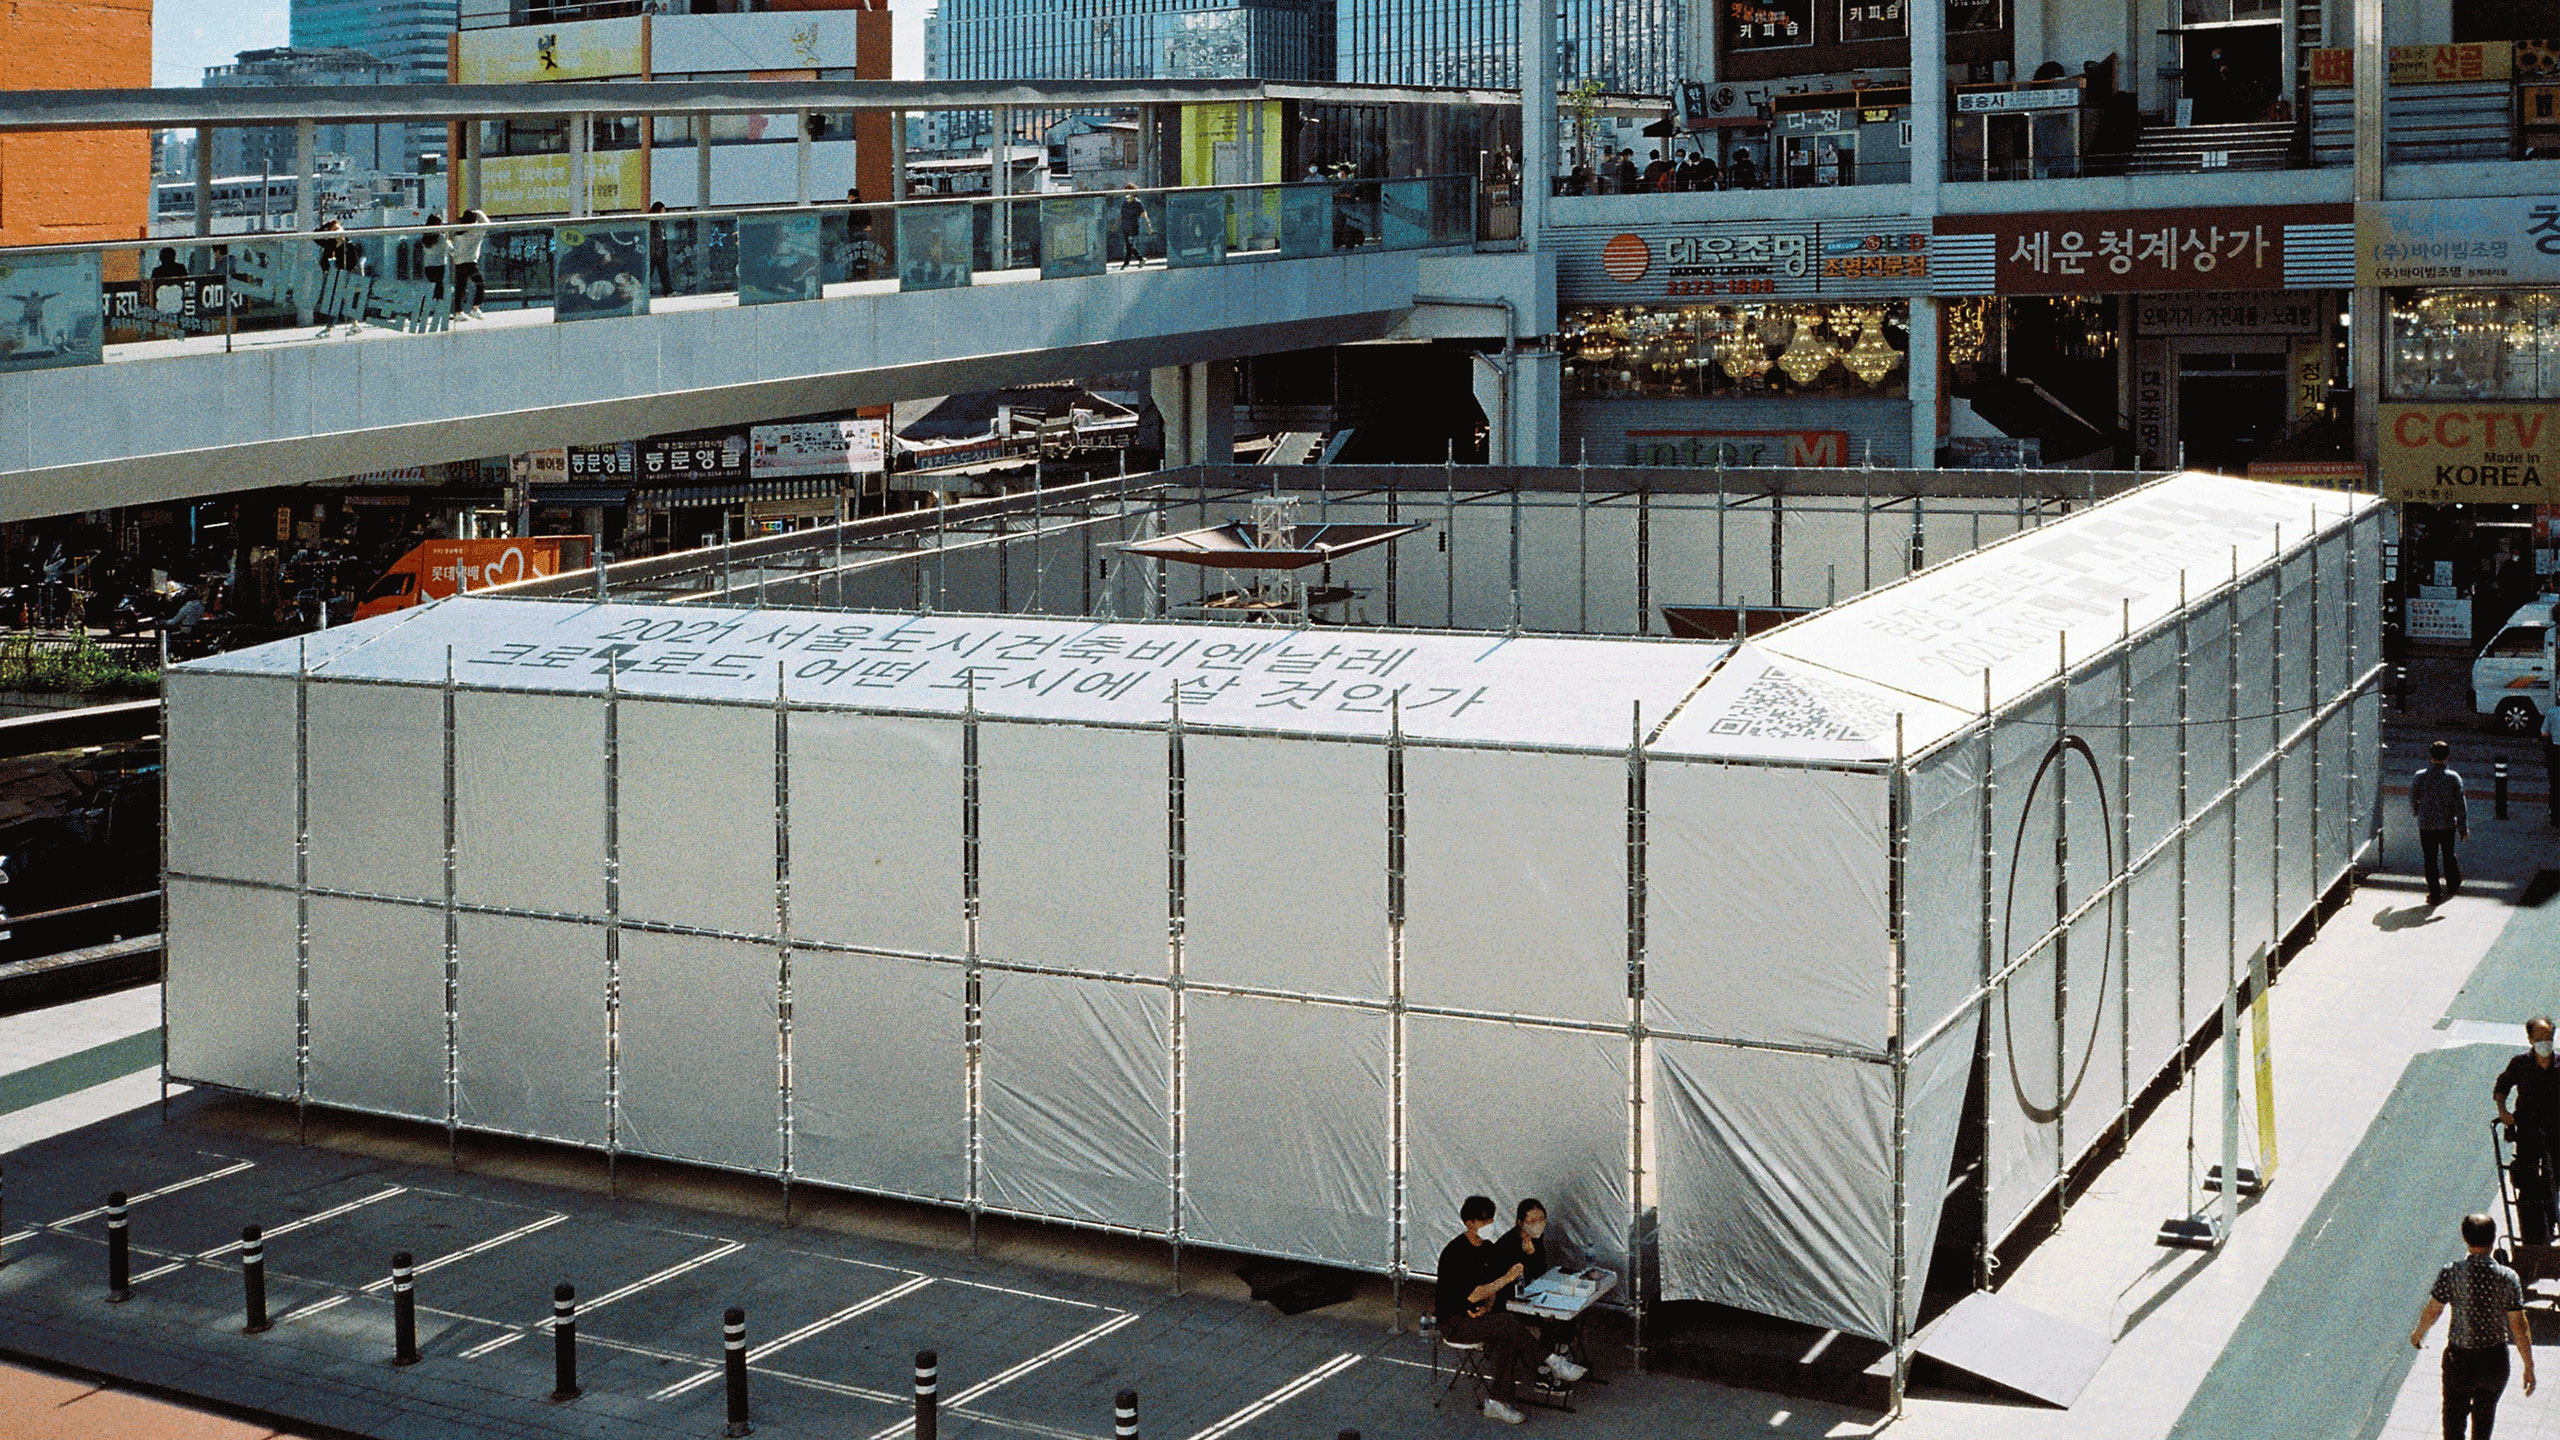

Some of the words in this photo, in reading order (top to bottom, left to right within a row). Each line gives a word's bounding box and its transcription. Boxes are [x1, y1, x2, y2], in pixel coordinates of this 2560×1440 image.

[1849, 5, 1899, 22] 커피숍
[1740, 21, 1798, 39] 커피숍
[2433, 45, 2483, 80] 산골
[1665, 235, 1807, 277] 대우조명
[2009, 224, 2270, 275] 세운청계상가
[1821, 255, 1926, 279] 조명전문점
[2143, 306, 2193, 327] 오락기기
[2273, 306, 2313, 327] 노래방
[2393, 411, 2547, 449] CCTV
[572, 453, 632, 473] 동문앵글
[646, 449, 740, 472] 동문앵글
[2485, 452, 2523, 463] Made
[2436, 465, 2542, 487] KOREA
[598, 617, 741, 645] 2021
[746, 623, 1417, 678] 서울도시건축비엔날레
[466, 643, 764, 681] 크로로드,
[794, 656, 930, 689] 어떤
[929, 664, 1150, 701] 도시에
[1162, 674, 1241, 706] 살
[1255, 678, 1486, 719] 것인가
